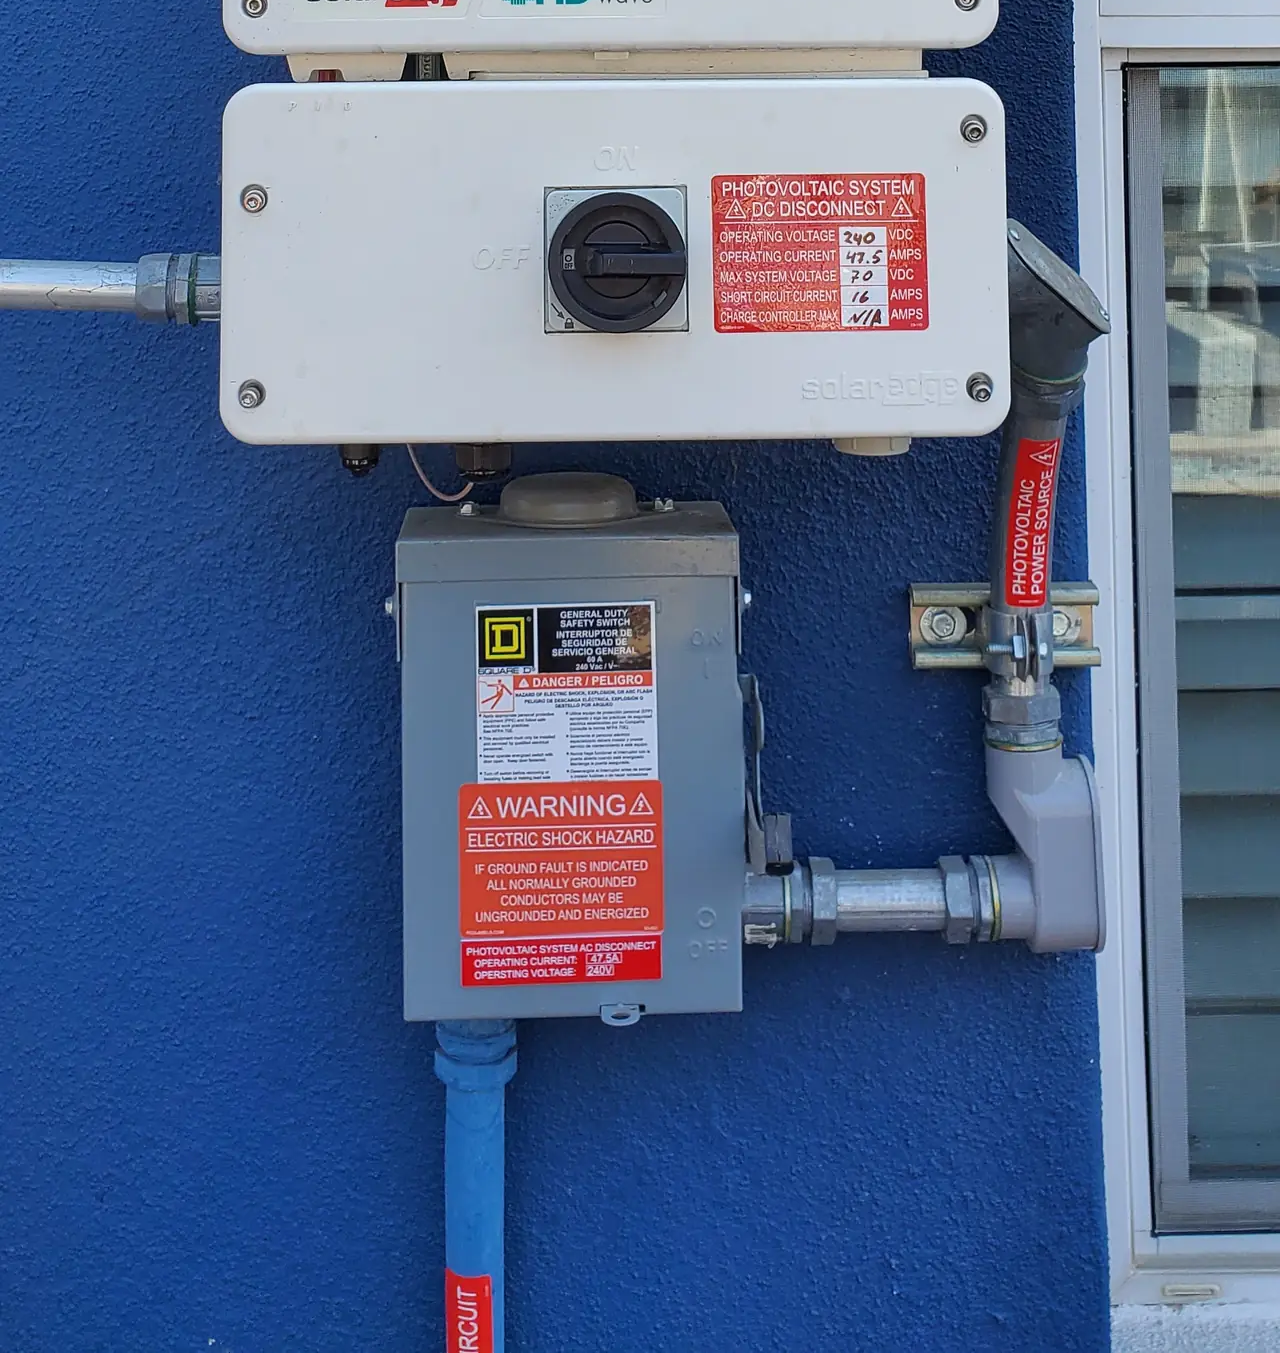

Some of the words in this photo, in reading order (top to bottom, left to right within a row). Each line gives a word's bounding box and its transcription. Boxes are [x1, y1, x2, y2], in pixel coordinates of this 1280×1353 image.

[594, 146, 638, 172] ON
[722, 180, 845, 197] PHOTOVOLTAIC
[848, 180, 914, 196] SYSTEM
[752, 201, 776, 218] DC
[779, 200, 886, 217] DISCONNECT
[720, 230, 783, 243] OPERATING
[786, 230, 836, 242] VOLTAGE
[844, 231, 876, 246] 240
[888, 228, 914, 241] VDC
[472, 245, 531, 270] OFF
[720, 250, 782, 263] OPERATING
[784, 250, 836, 262] CURRENT
[846, 250, 884, 264] 47.5
[889, 248, 922, 260] AMPS
[720, 271, 743, 283] MAX
[744, 270, 787, 282] SYSTEM
[789, 270, 836, 282] VOLTAGE
[851, 270, 873, 284] 70
[890, 268, 914, 281] VDC
[720, 291, 752, 304] SHORT
[754, 291, 792, 303] CIRCUIT
[792, 290, 838, 302] CURRENT
[852, 290, 870, 304] 16
[890, 288, 922, 300] AMPS
[720, 311, 757, 323] CHARGE
[758, 310, 816, 323] CONTROLLER
[819, 310, 838, 321] MAX
[848, 308, 882, 328] N/A
[890, 308, 924, 320] AMPS
[1034, 469, 1053, 530] SOURCE
[1012, 479, 1035, 596] PHOTOVOLTAIC
[1031, 532, 1047, 596] POWER
[560, 610, 602, 619] GENERAL
[604, 610, 628, 618] DUTY
[560, 618, 594, 628] SAFETY
[596, 618, 630, 627] SWITCH
[556, 629, 618, 639] INTERRUPTOR
[620, 628, 632, 637] DE
[692, 628, 723, 647] ON
[562, 638, 613, 648] SEGURIDAD
[615, 638, 628, 646] DE
[552, 648, 593, 656] SERVICIO
[595, 647, 636, 655] GENERAL
[532, 676, 582, 688] DANGER
[585, 676, 589, 686] /
[592, 674, 644, 685] PELIGRO
[496, 794, 626, 818] WARNING
[468, 832, 538, 848] ELECTRIC
[542, 830, 592, 846] SHOCK
[596, 828, 654, 844] HAZARD
[475, 864, 486, 875] IF
[488, 862, 538, 874] GROUND
[540, 861, 573, 873] FAULT
[576, 860, 587, 872] IS
[590, 860, 648, 872] INDICATED
[486, 879, 508, 890] ALL
[508, 877, 568, 890] NORMALLY
[572, 876, 637, 888] GROUNDED
[500, 893, 580, 906] CONDUCTORS
[582, 892, 606, 904] MAY
[608, 892, 624, 904] BE
[475, 909, 556, 923] UNGROUNDED
[558, 908, 582, 920] AND
[584, 907, 649, 920] ENERGIZED
[466, 946, 538, 956] PHOTOVOLTAIC
[539, 944, 578, 954] SYSTEM
[580, 944, 593, 952] AC
[595, 941, 656, 951] DISCONNECT
[474, 958, 528, 968] OPERATING
[530, 956, 577, 966] CURRENT:
[590, 954, 620, 964] 47.5A
[474, 970, 530, 980] OPERSTING
[532, 968, 576, 978] VOLTAGE:
[587, 966, 613, 976] 240V
